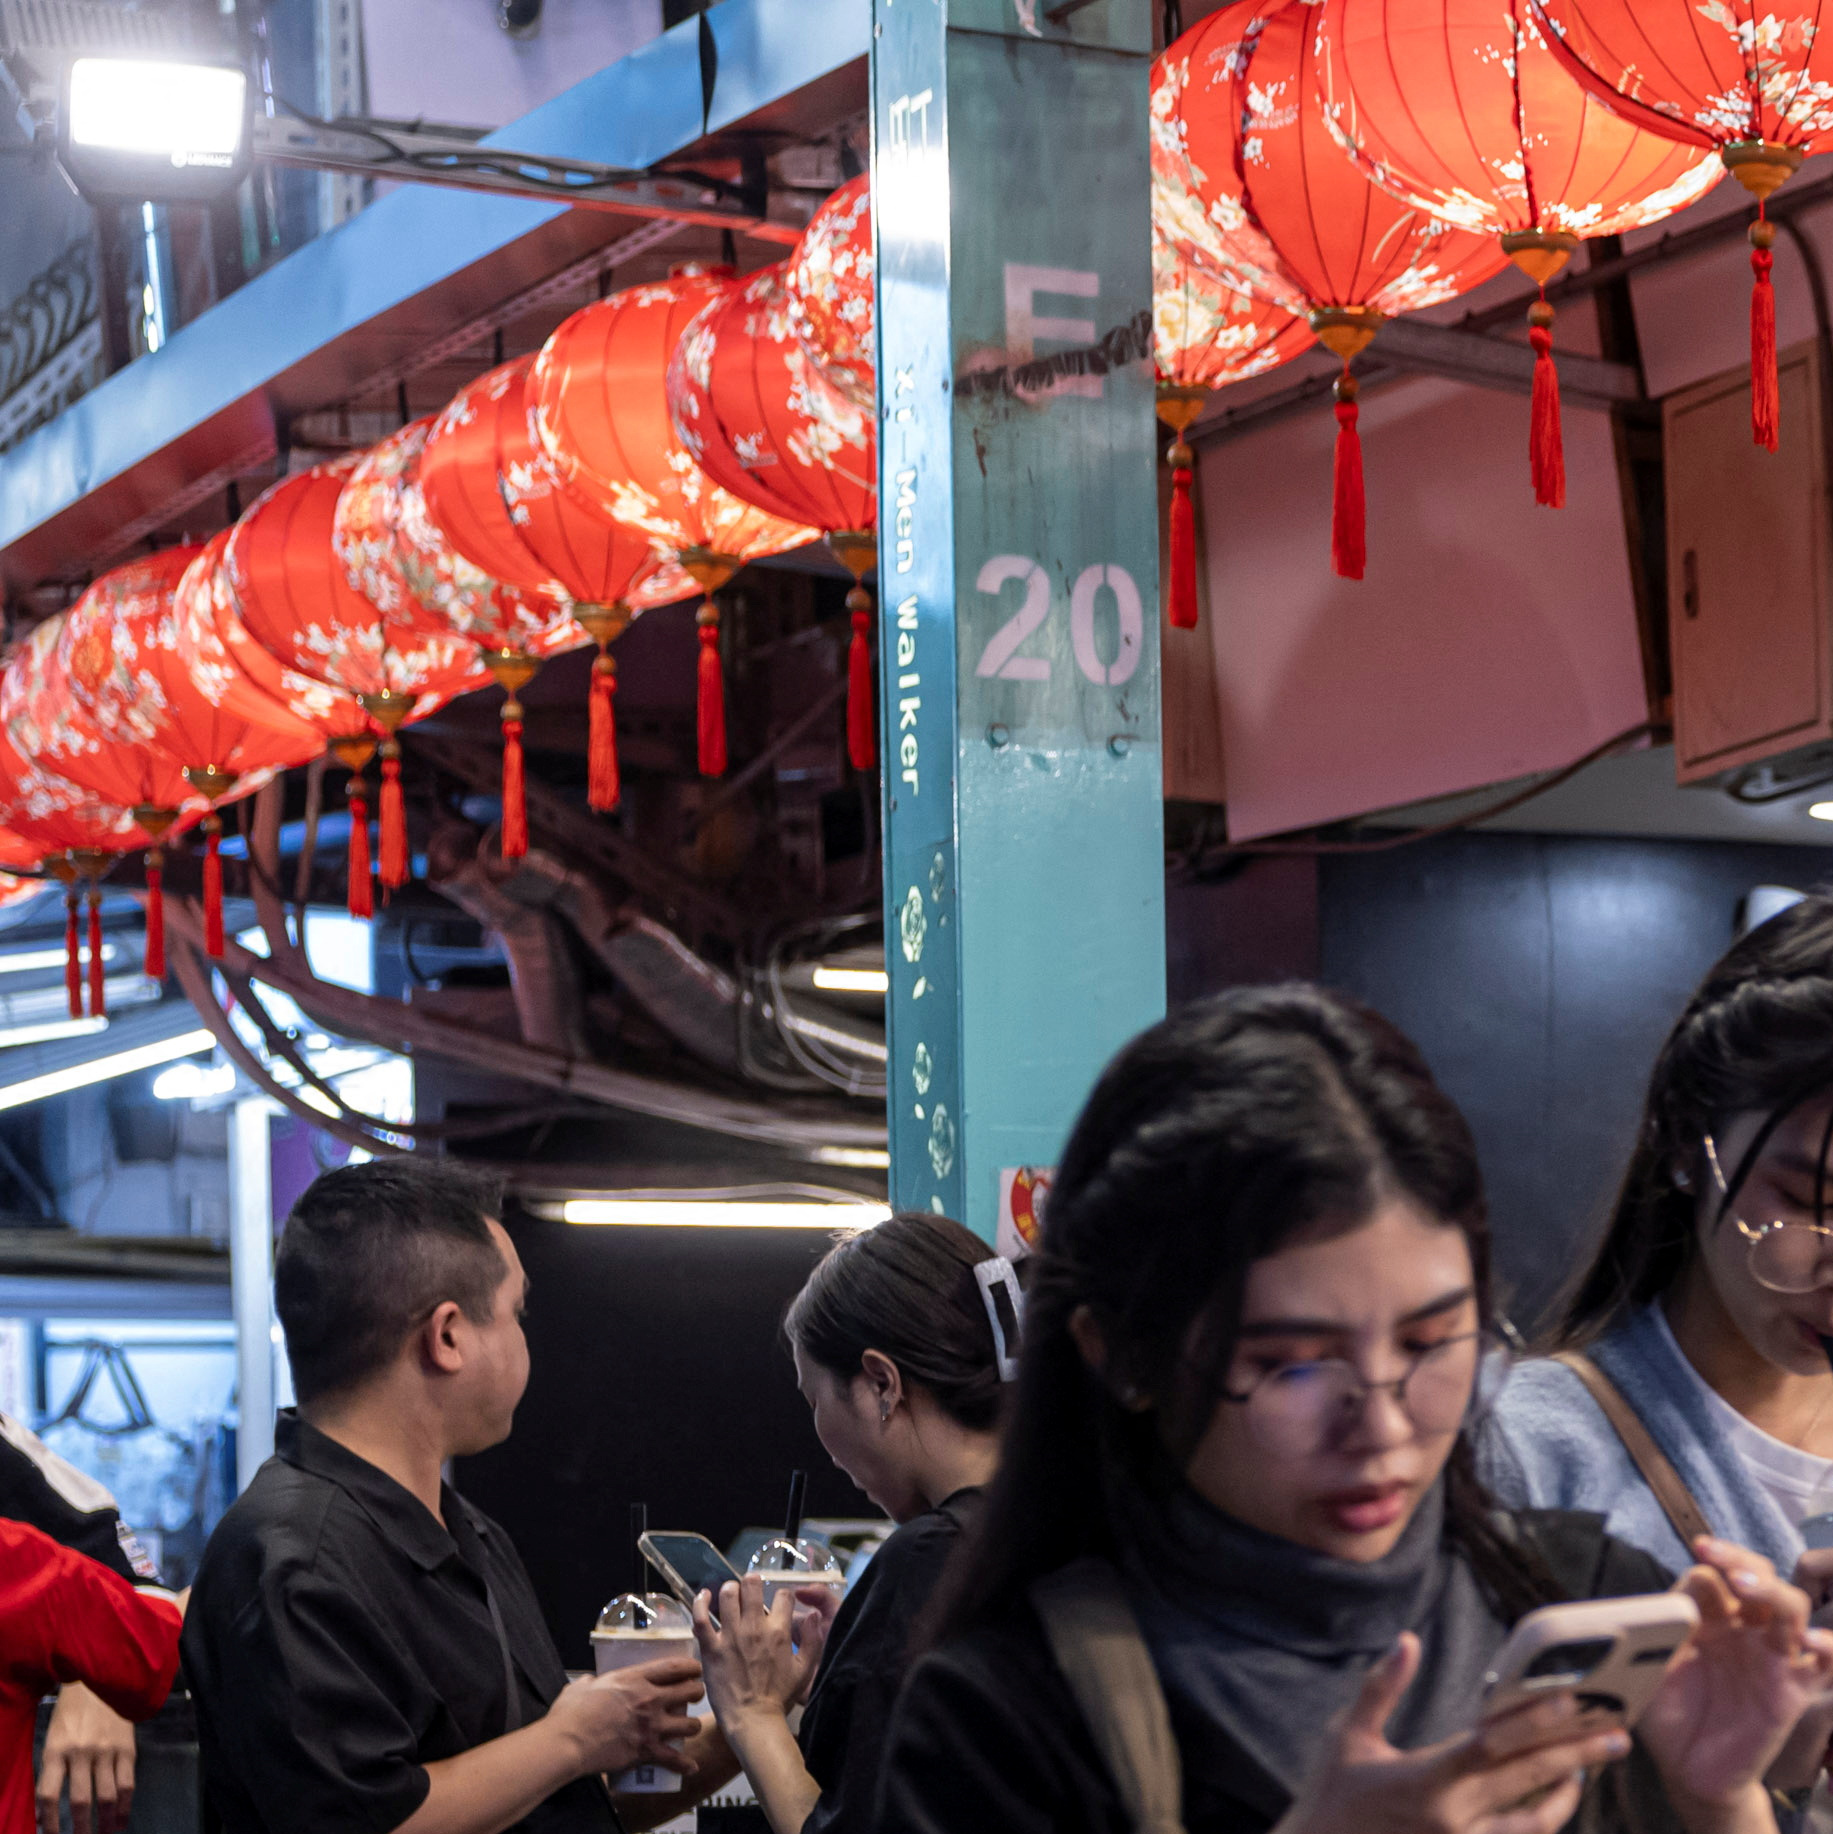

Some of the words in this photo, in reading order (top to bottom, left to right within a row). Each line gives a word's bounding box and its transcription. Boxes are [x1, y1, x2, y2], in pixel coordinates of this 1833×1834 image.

[1004, 262, 1103, 399] E
[975, 554, 1144, 687] 20
[897, 594, 922, 797] Walker
